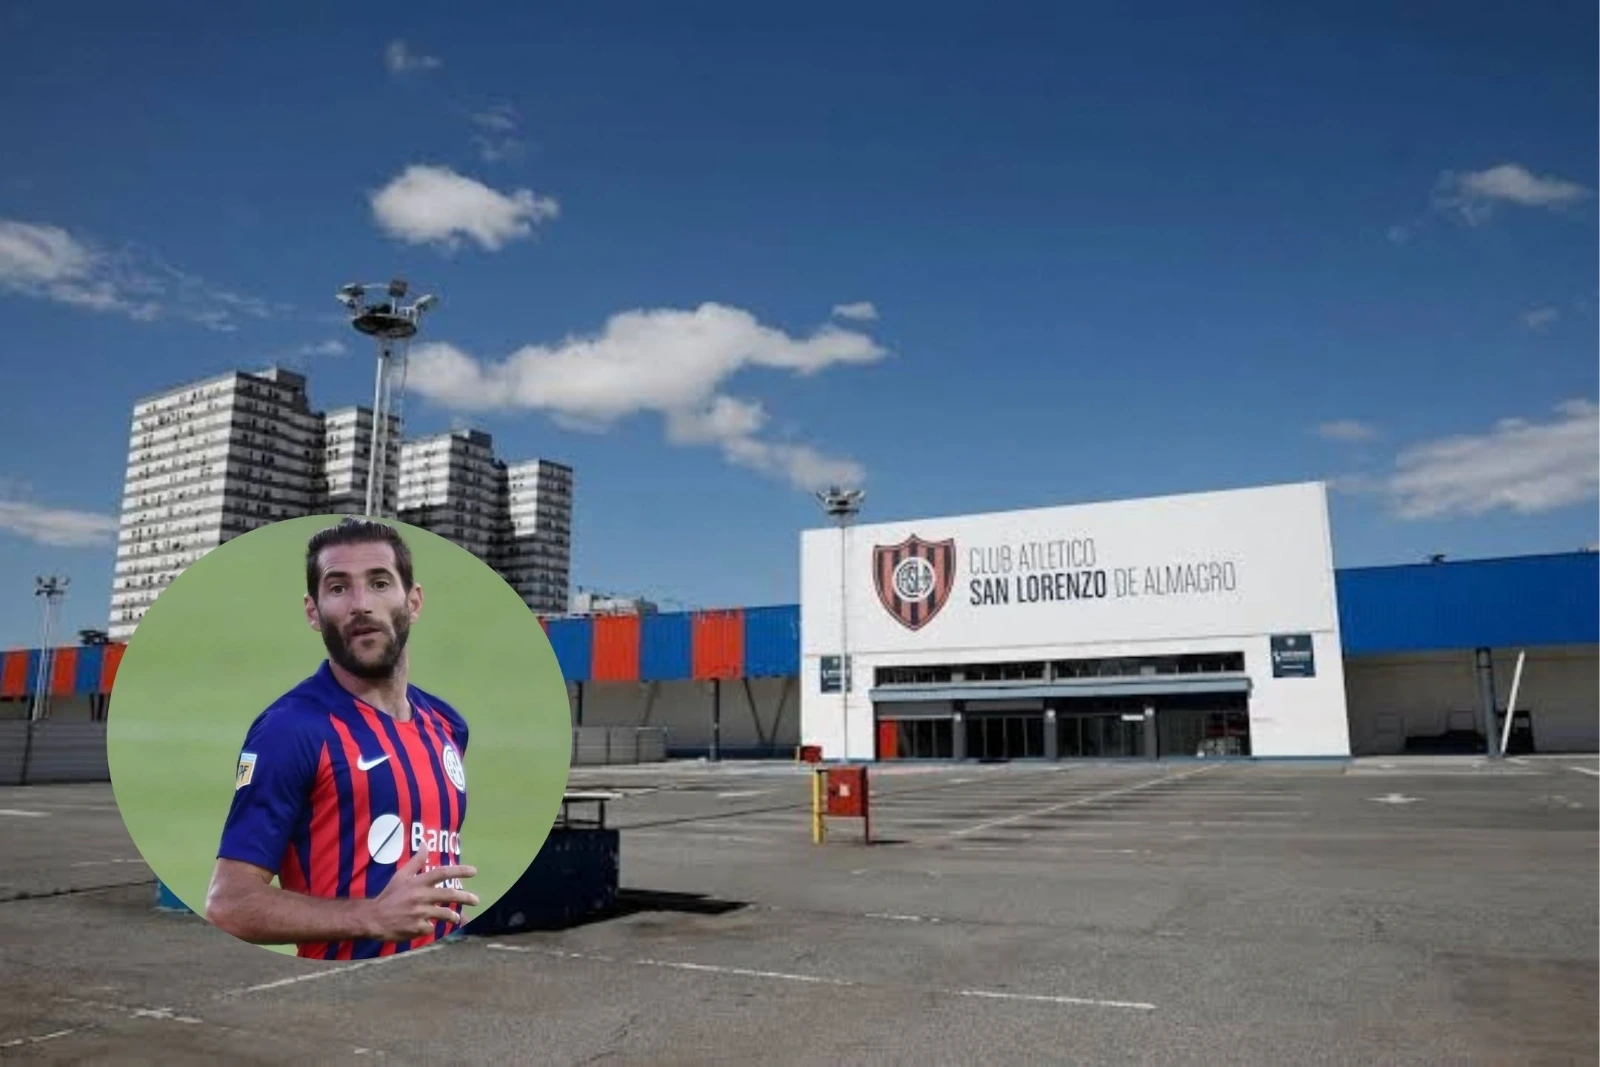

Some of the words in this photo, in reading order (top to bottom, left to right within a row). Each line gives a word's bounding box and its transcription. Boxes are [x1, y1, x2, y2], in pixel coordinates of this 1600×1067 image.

[970, 545, 1012, 574] CLUB
[1019, 539, 1096, 569] ATLETICO
[970, 577, 1010, 605] SAN
[1016, 570, 1107, 603] LORENZO
[1115, 568, 1138, 598] DE
[1144, 561, 1235, 595] ALMAGRO
